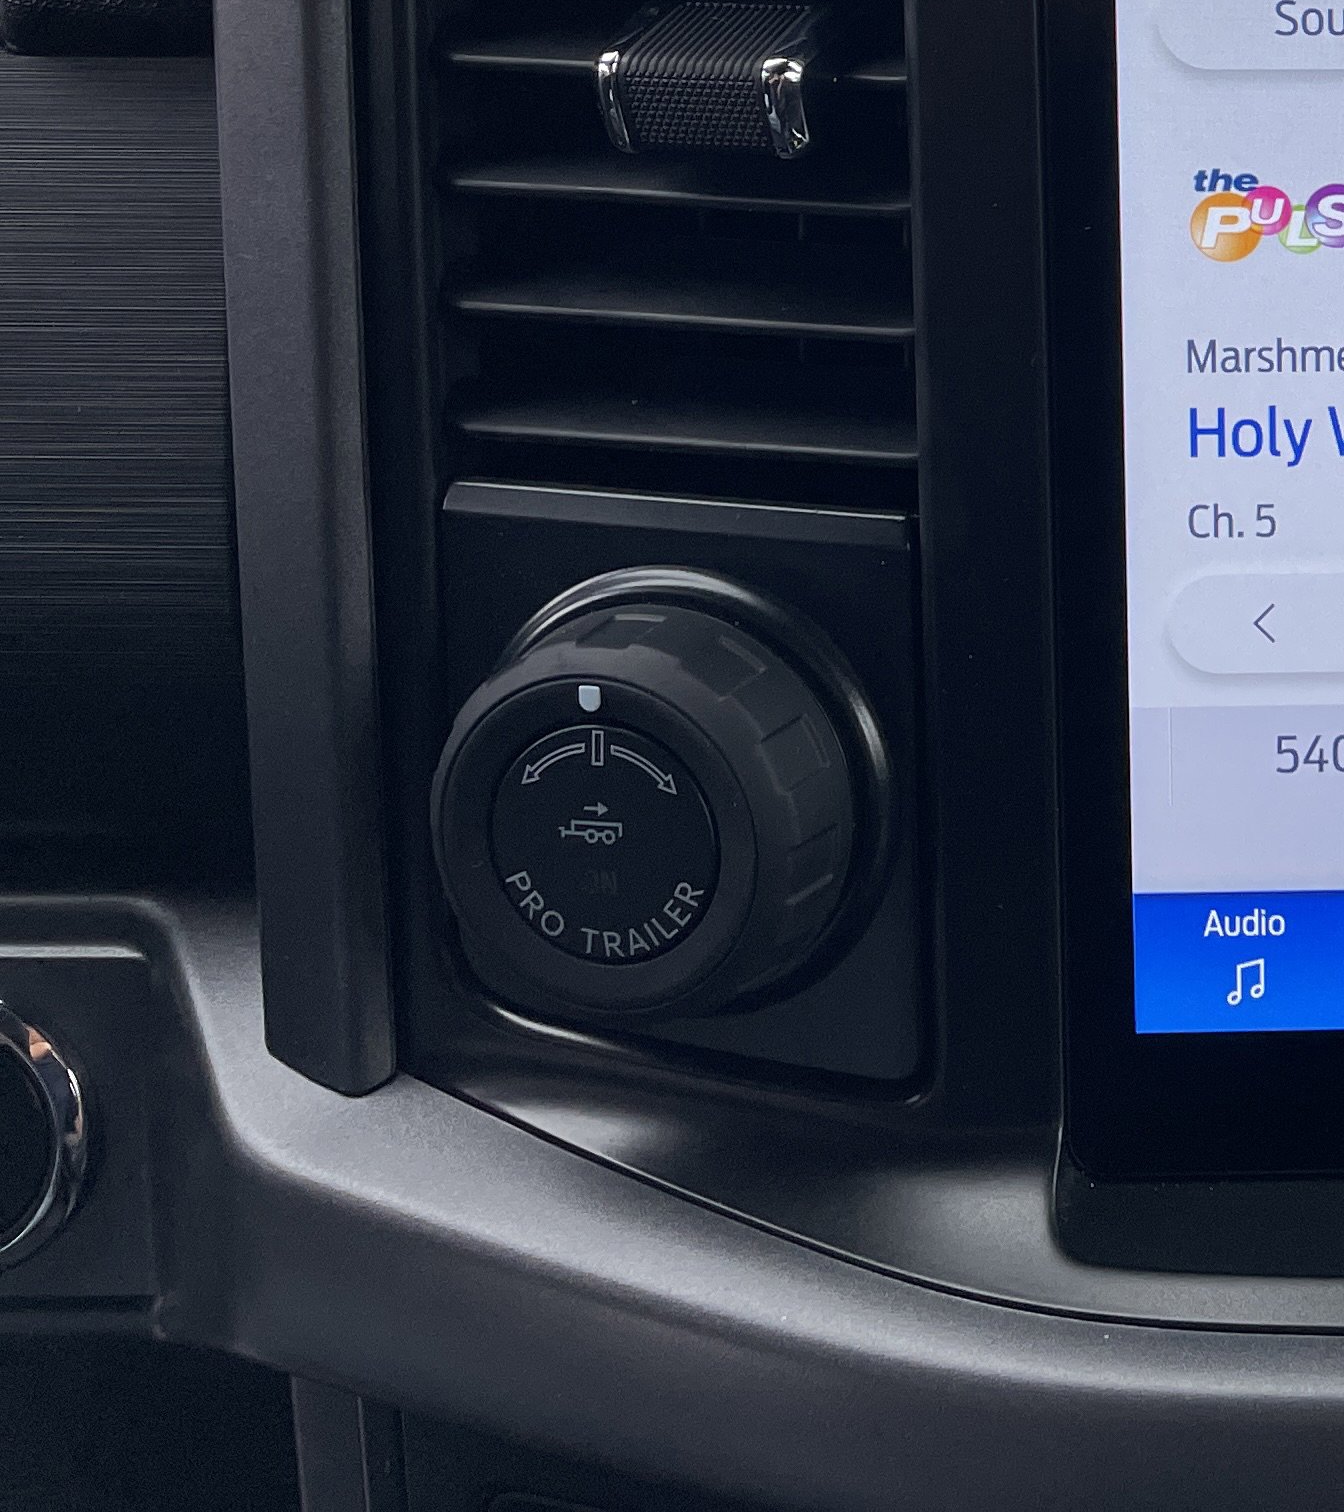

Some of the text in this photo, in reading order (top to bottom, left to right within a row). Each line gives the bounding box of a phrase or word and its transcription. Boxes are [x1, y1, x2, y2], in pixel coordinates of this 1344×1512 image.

[1193, 168, 1260, 192] the
[1189, 404, 1313, 468] Holy
[1188, 502, 1277, 539] Ch. 5
[505, 871, 705, 957] PRO TRAILER
[1203, 908, 1286, 937] Audio
